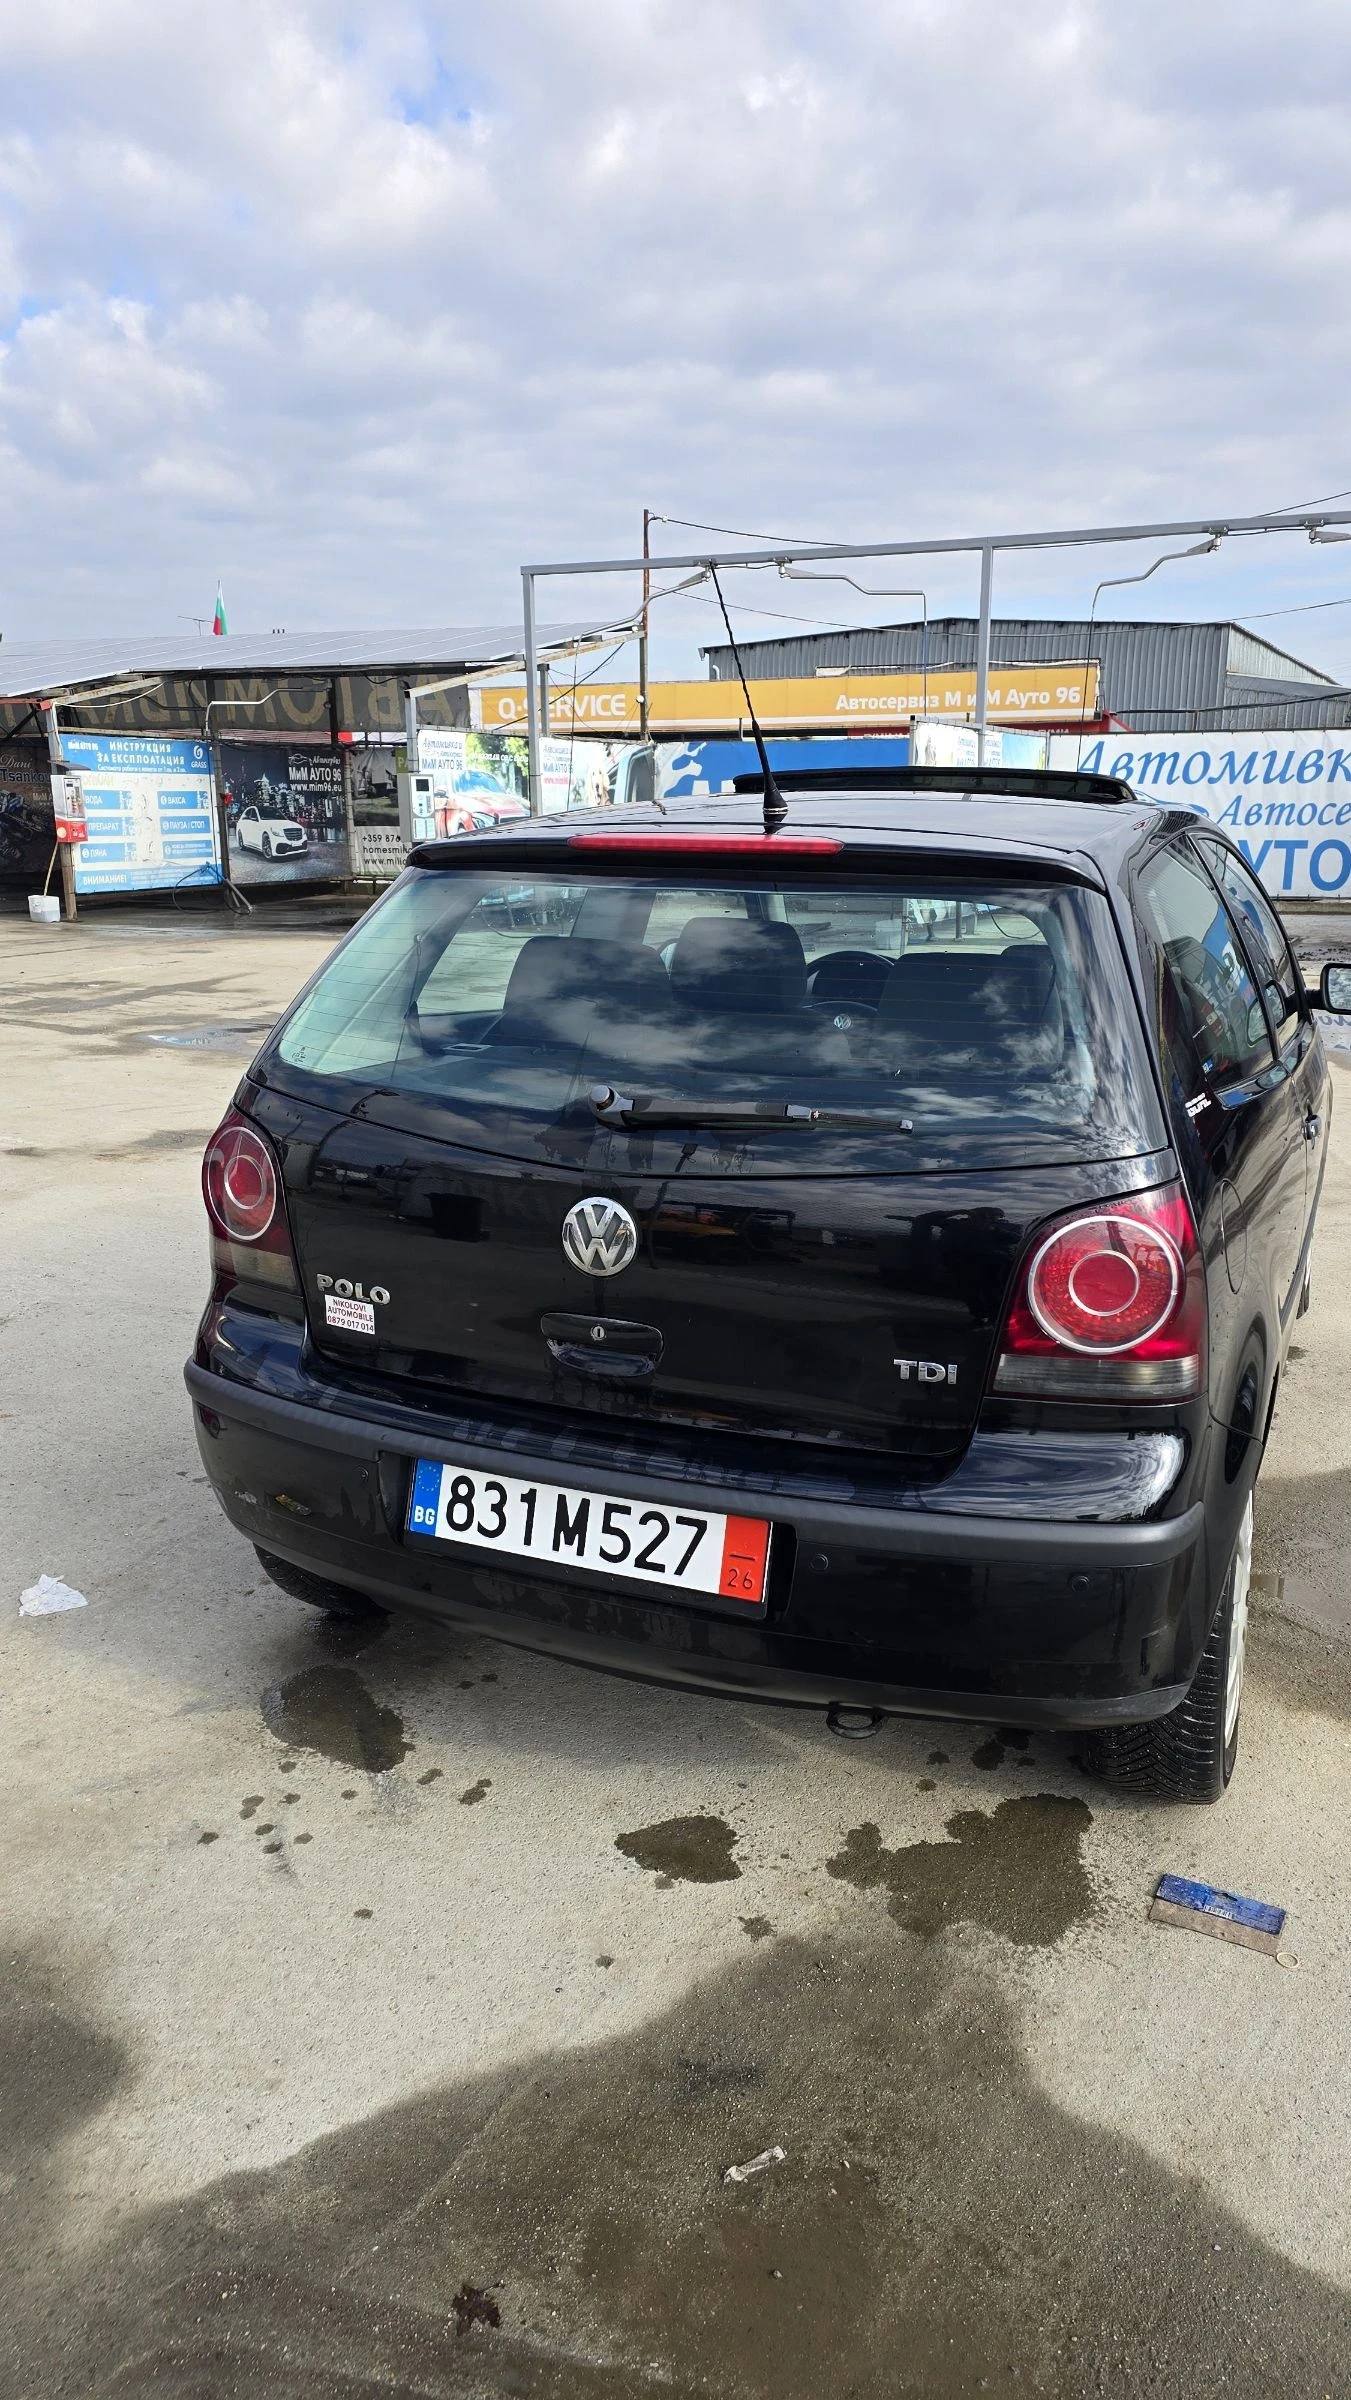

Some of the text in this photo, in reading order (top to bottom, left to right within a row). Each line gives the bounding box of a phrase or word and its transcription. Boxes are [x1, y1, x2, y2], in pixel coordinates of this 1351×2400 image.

[836, 694, 939, 712] Автосервиз
[1006, 688, 1050, 708] Ауто
[1056, 686, 1080, 703] 96
[110, 742, 171, 754] ИНСТРУКЦИЯ
[97, 753, 109, 763] ЗА
[289, 767, 342, 781] МиМ АУТО 96
[290, 782, 342, 791] www.mim96.eu
[1237, 838, 1351, 892] УТО
[562, 1196, 637, 1278] VW
[317, 1273, 391, 1306] POLO
[328, 1306, 374, 1323] AUTOMOBILE
[332, 1298, 367, 1313] NIKOLOVI
[327, 1315, 374, 1332] 0879 017 014
[893, 1358, 958, 1385] TDI
[413, 1504, 436, 1526] BG
[727, 1568, 754, 1590] 26
